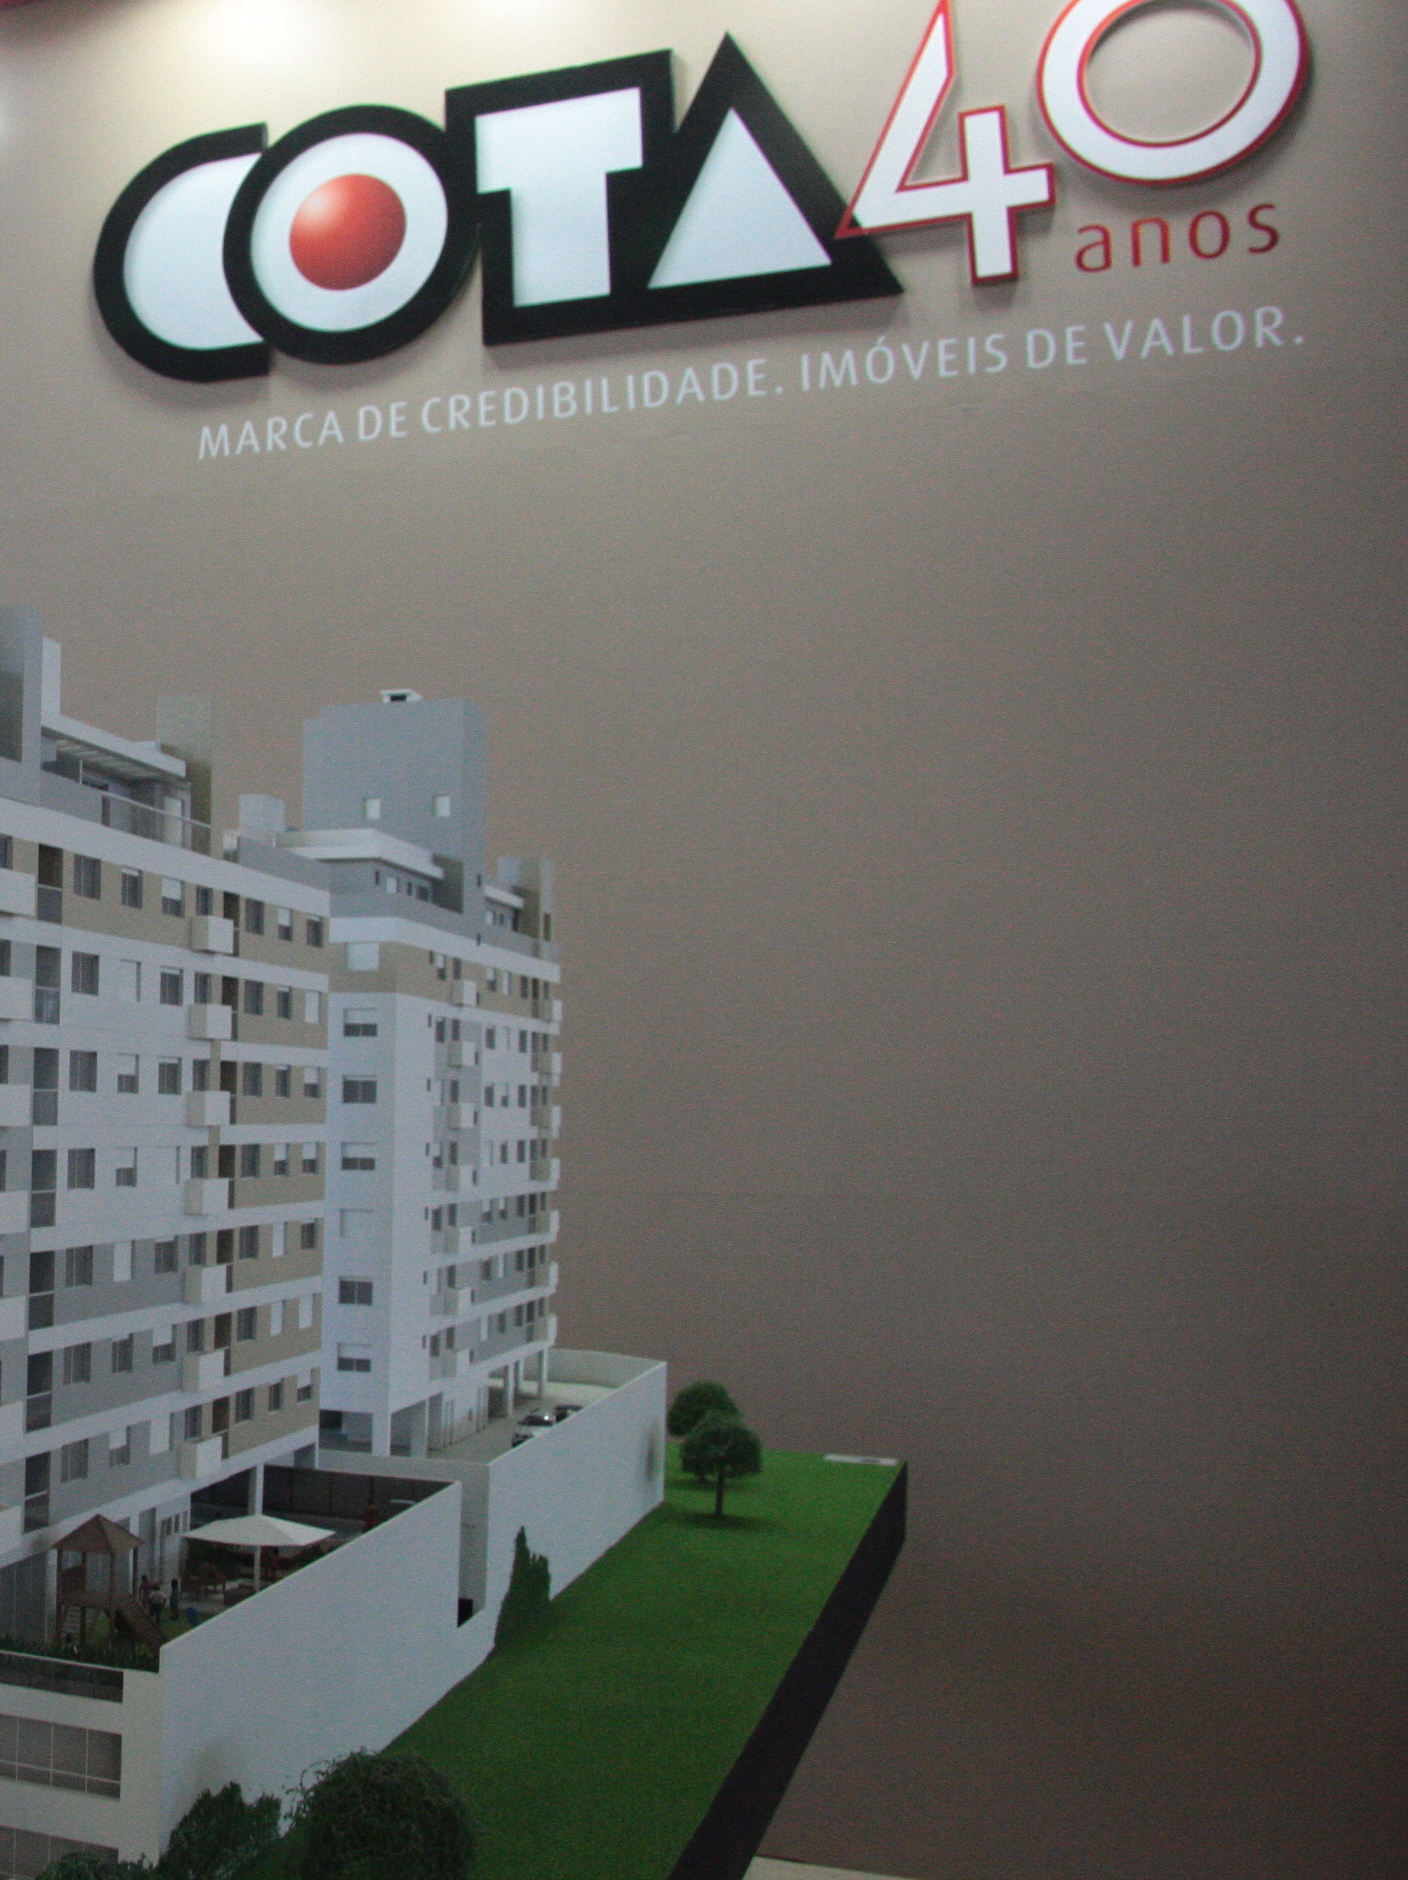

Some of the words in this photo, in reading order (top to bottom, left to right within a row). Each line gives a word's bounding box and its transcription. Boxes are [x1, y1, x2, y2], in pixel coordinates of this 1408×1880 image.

[92, 30, 905, 384] COTA
[833, 0, 1311, 284] 40
[1075, 203, 1281, 273] anos
[197, 409, 345, 461] MARCA
[357, 401, 407, 442] DE
[421, 358, 783, 435] CREDIBILIDADE.
[799, 333, 1009, 392] IMÓVEIS
[1025, 325, 1088, 369] DE
[1103, 305, 1305, 362] VALOR.
